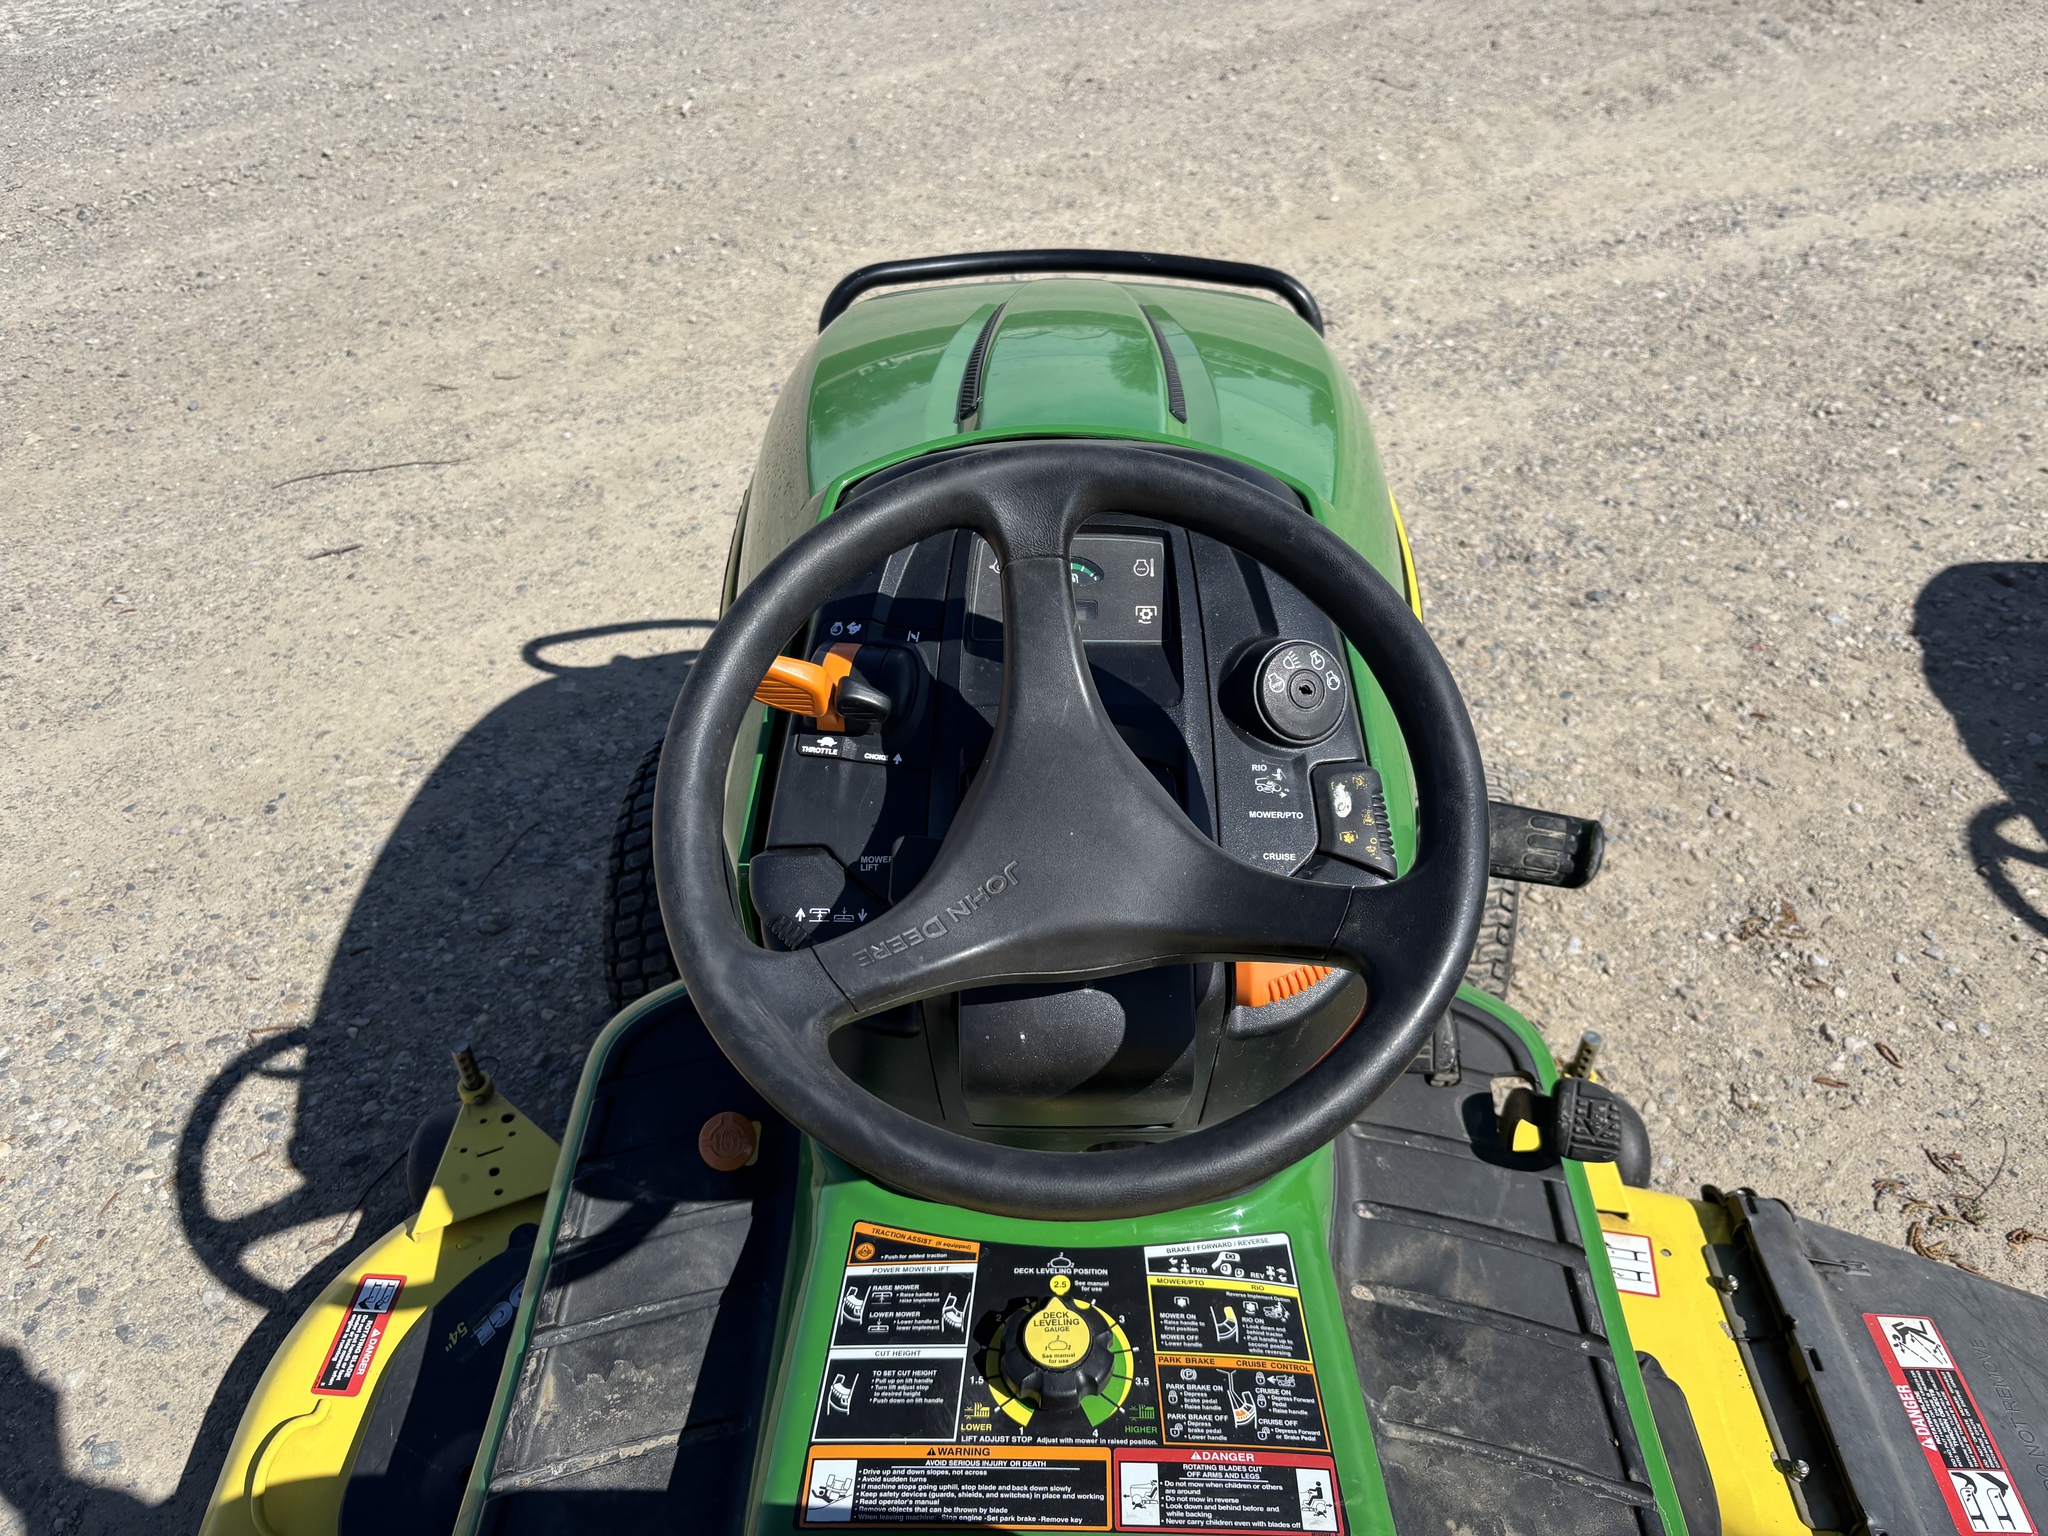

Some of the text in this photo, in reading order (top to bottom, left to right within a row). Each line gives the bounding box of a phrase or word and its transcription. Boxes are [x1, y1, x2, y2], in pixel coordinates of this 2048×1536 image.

[801, 746, 838, 755] THROTTLE
[1249, 811, 1304, 819] MOWER/PTO
[1263, 852, 1296, 861] CRUISE
[852, 860, 1019, 967] JOHN DEERE
[872, 1228, 932, 1245] TRACTION ASSIST
[1166, 1237, 1269, 1254] BRAKE FORWARD REVERSE
[1156, 1278, 1205, 1286] MOWER/PTO
[1033, 1319, 1080, 1327] LEVELING
[1119, 1315, 1125, 1323] 3
[445, 1321, 468, 1352] 54"
[344, 1321, 373, 1378] ROTATING BLADE
[357, 1337, 377, 1375] DANGER
[1185, 1357, 1215, 1365] BRAKE
[1236, 1360, 1311, 1372] CRUISE CONTROL
[970, 1376, 984, 1384] 1.5
[1135, 1377, 1150, 1385] 3.5
[1255, 1387, 1279, 1395] CRUISE
[1968, 1339, 2046, 1456] NOT REMOVE
[1896, 1384, 1931, 1438] DANGER
[1914, 1390, 1942, 1444] ROTATING BLADE
[1258, 1418, 1283, 1426] CRUISE
[960, 1423, 992, 1432] LOWER
[1019, 1427, 1024, 1435] 1
[1124, 1425, 1158, 1434] HIGHER
[1092, 1428, 1098, 1437] 4
[961, 1435, 978, 1443] LIFT
[1036, 1437, 1058, 1445] Adjust
[1127, 1438, 1159, 1446] position.
[938, 1447, 990, 1456] WARNING
[1202, 1452, 1255, 1462] DANGER
[1218, 1465, 1247, 1473] BLADES
[1050, 1485, 1071, 1493] slowly
[1262, 1483, 1283, 1491] others
